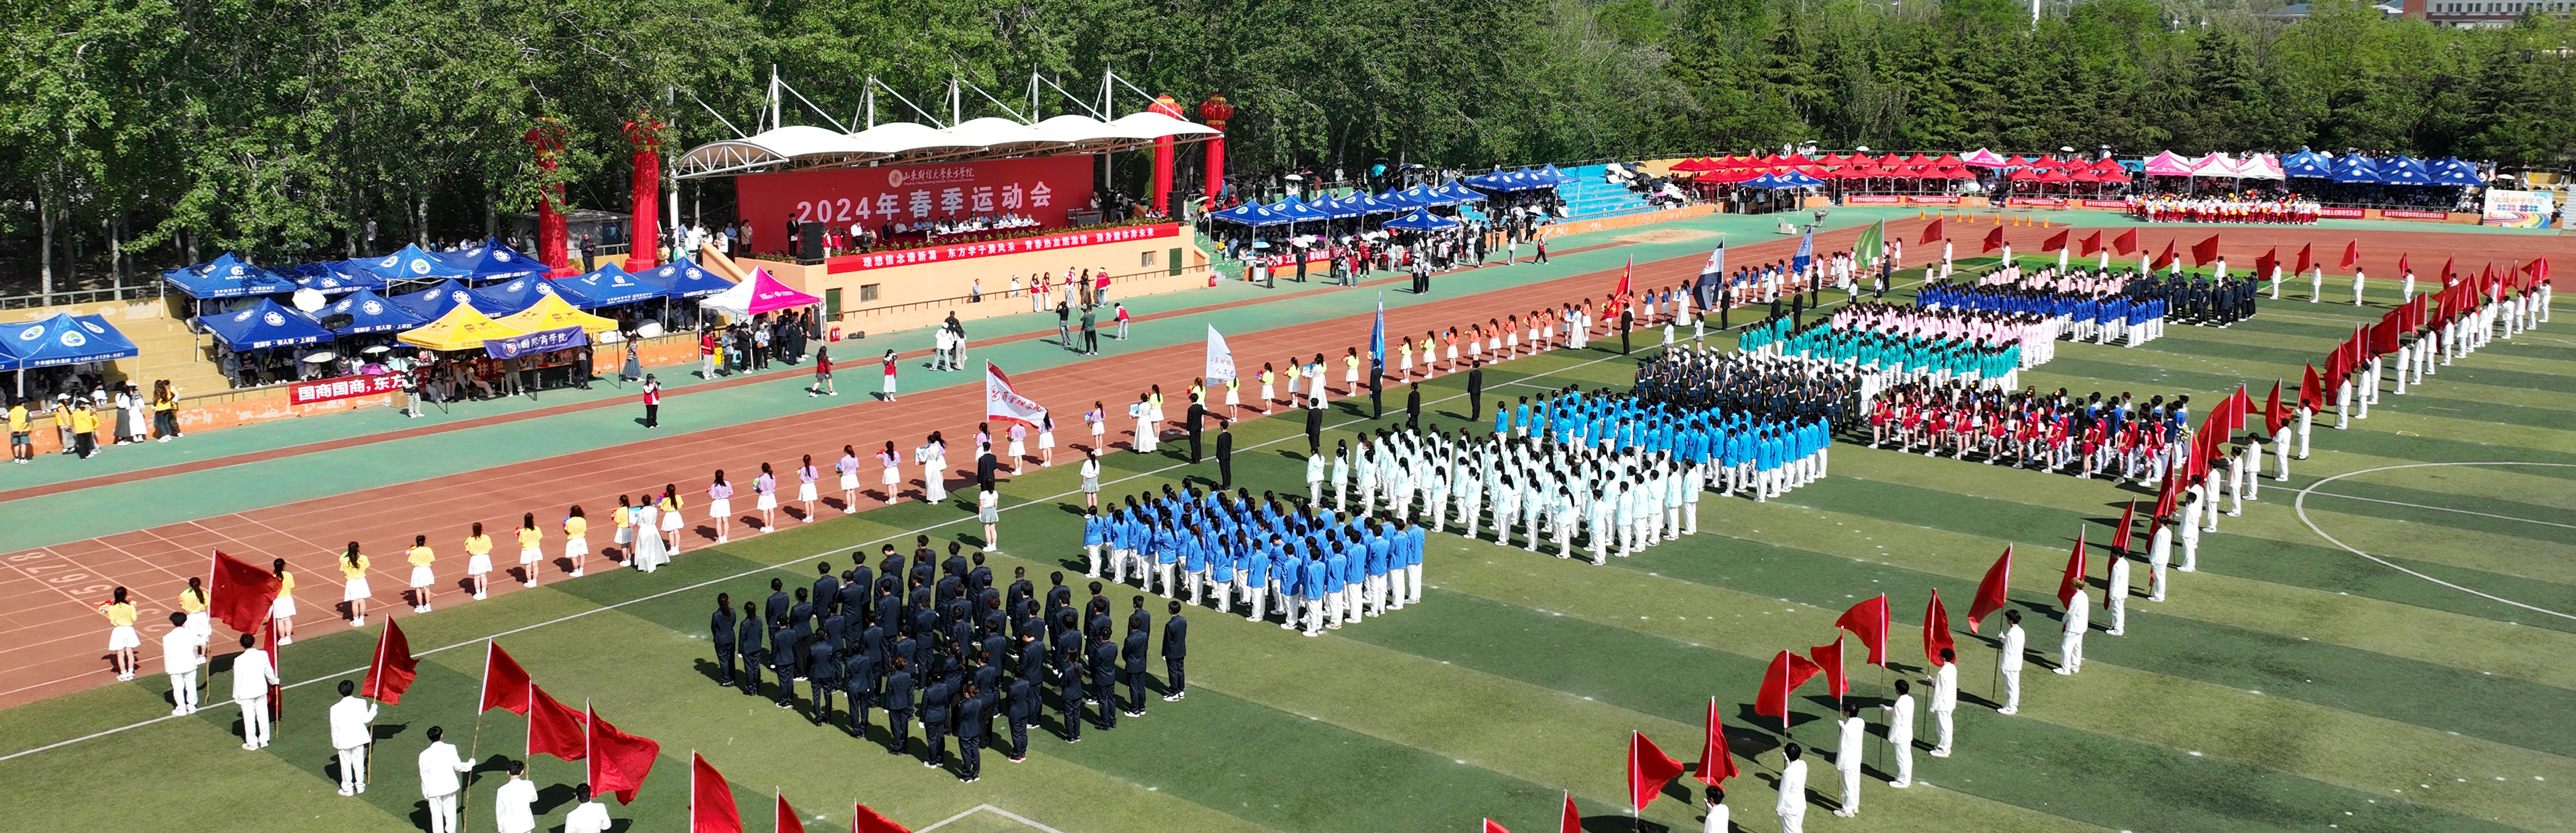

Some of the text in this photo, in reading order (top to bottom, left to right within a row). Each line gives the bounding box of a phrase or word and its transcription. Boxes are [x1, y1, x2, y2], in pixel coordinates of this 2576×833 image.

[797, 181, 1051, 224] 2024年春季运动会
[863, 227, 1154, 268] 理想信念谱新篇 东方学子展风采 青春热血燃激情 强身健体奔未来
